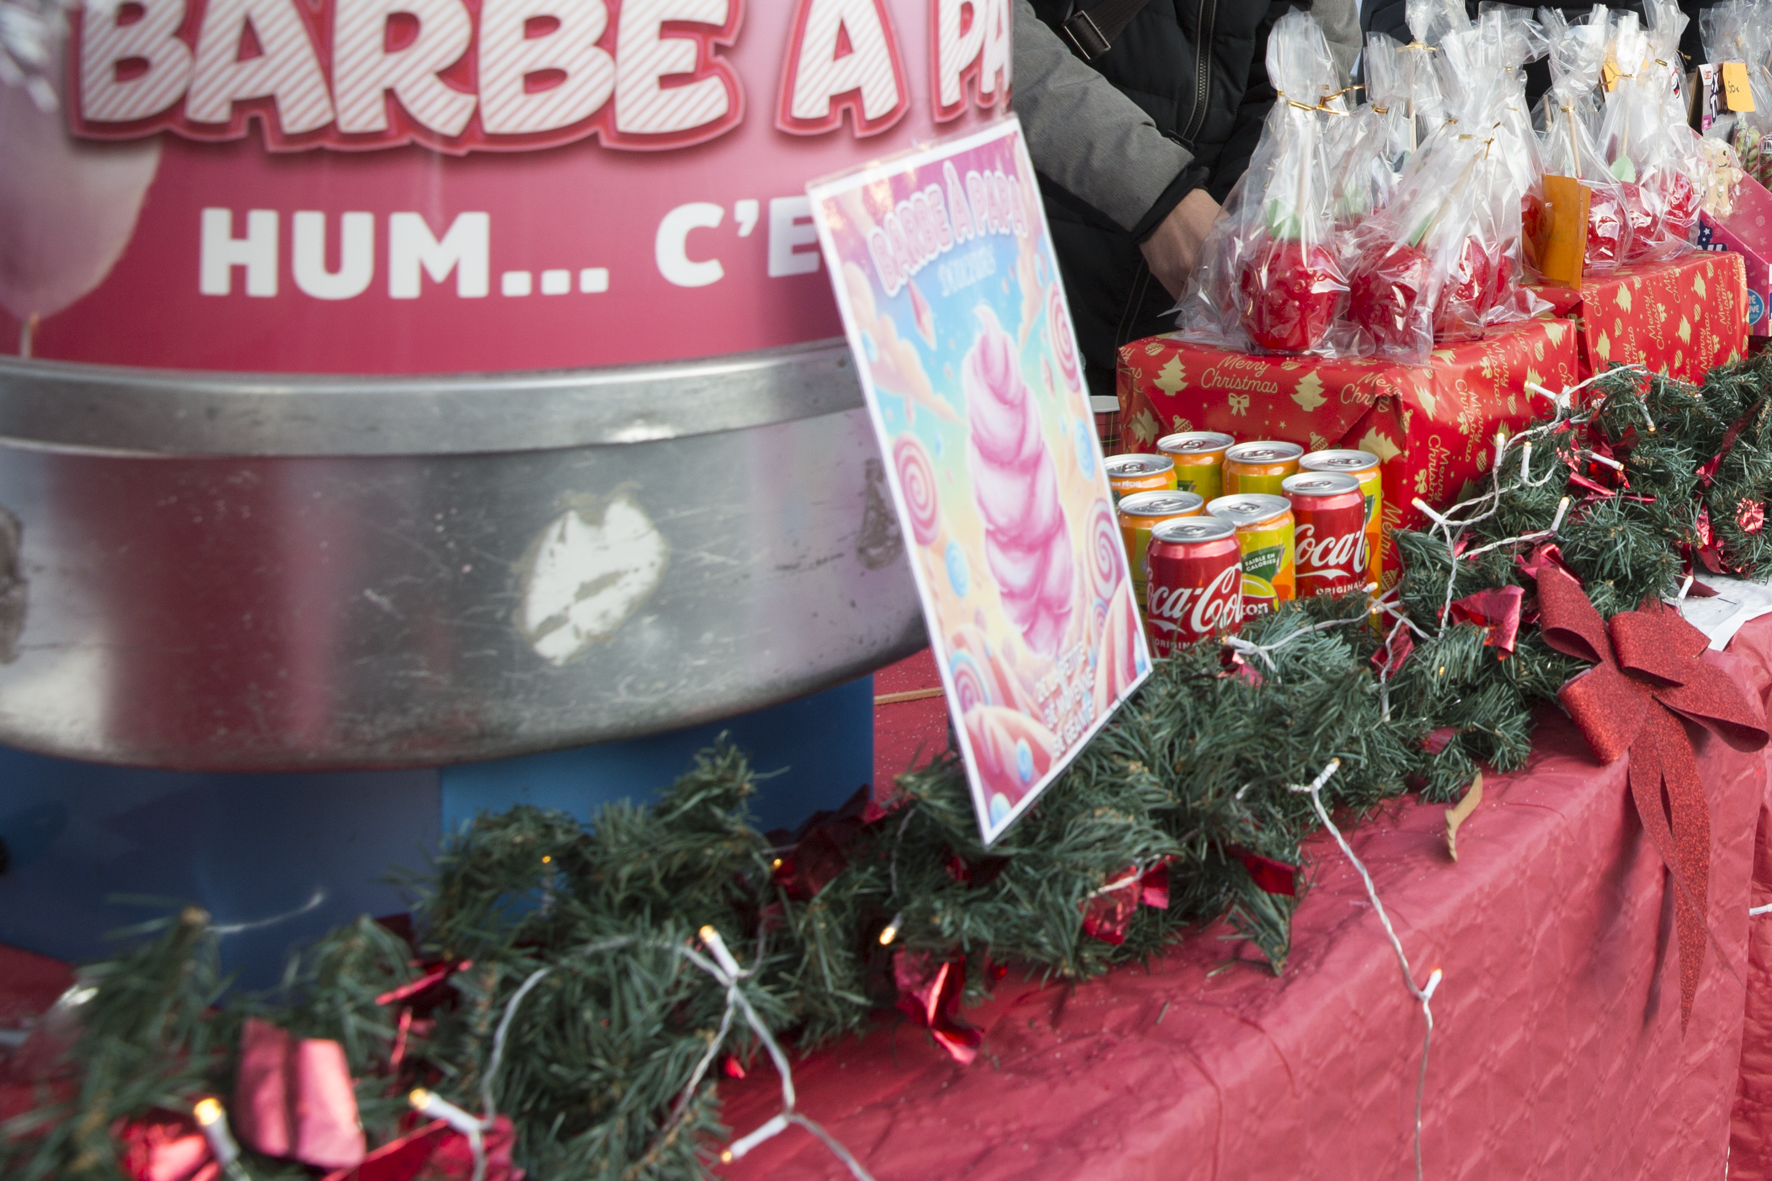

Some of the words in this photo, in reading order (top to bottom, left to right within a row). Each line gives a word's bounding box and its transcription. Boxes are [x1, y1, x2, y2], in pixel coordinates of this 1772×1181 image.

[199, 207, 609, 299] HUM...
[654, 198, 818, 290] C'E
[867, 183, 954, 297] BARBE
[965, 169, 1028, 239] PAPA
[1643, 294, 1657, 340] Merry
[1646, 279, 1665, 350] Christmas
[1715, 283, 1728, 326] Merry
[1200, 369, 1279, 395] Christmas
[1221, 354, 1271, 379] Merry
[1492, 341, 1510, 388] Merry
[1455, 378, 1478, 464] Christmas
[1468, 391, 1485, 443] Merry
[1435, 445, 1451, 503] Merry
[1245, 558, 1277, 572] CALORIES
[1265, 552, 1276, 562] EN
